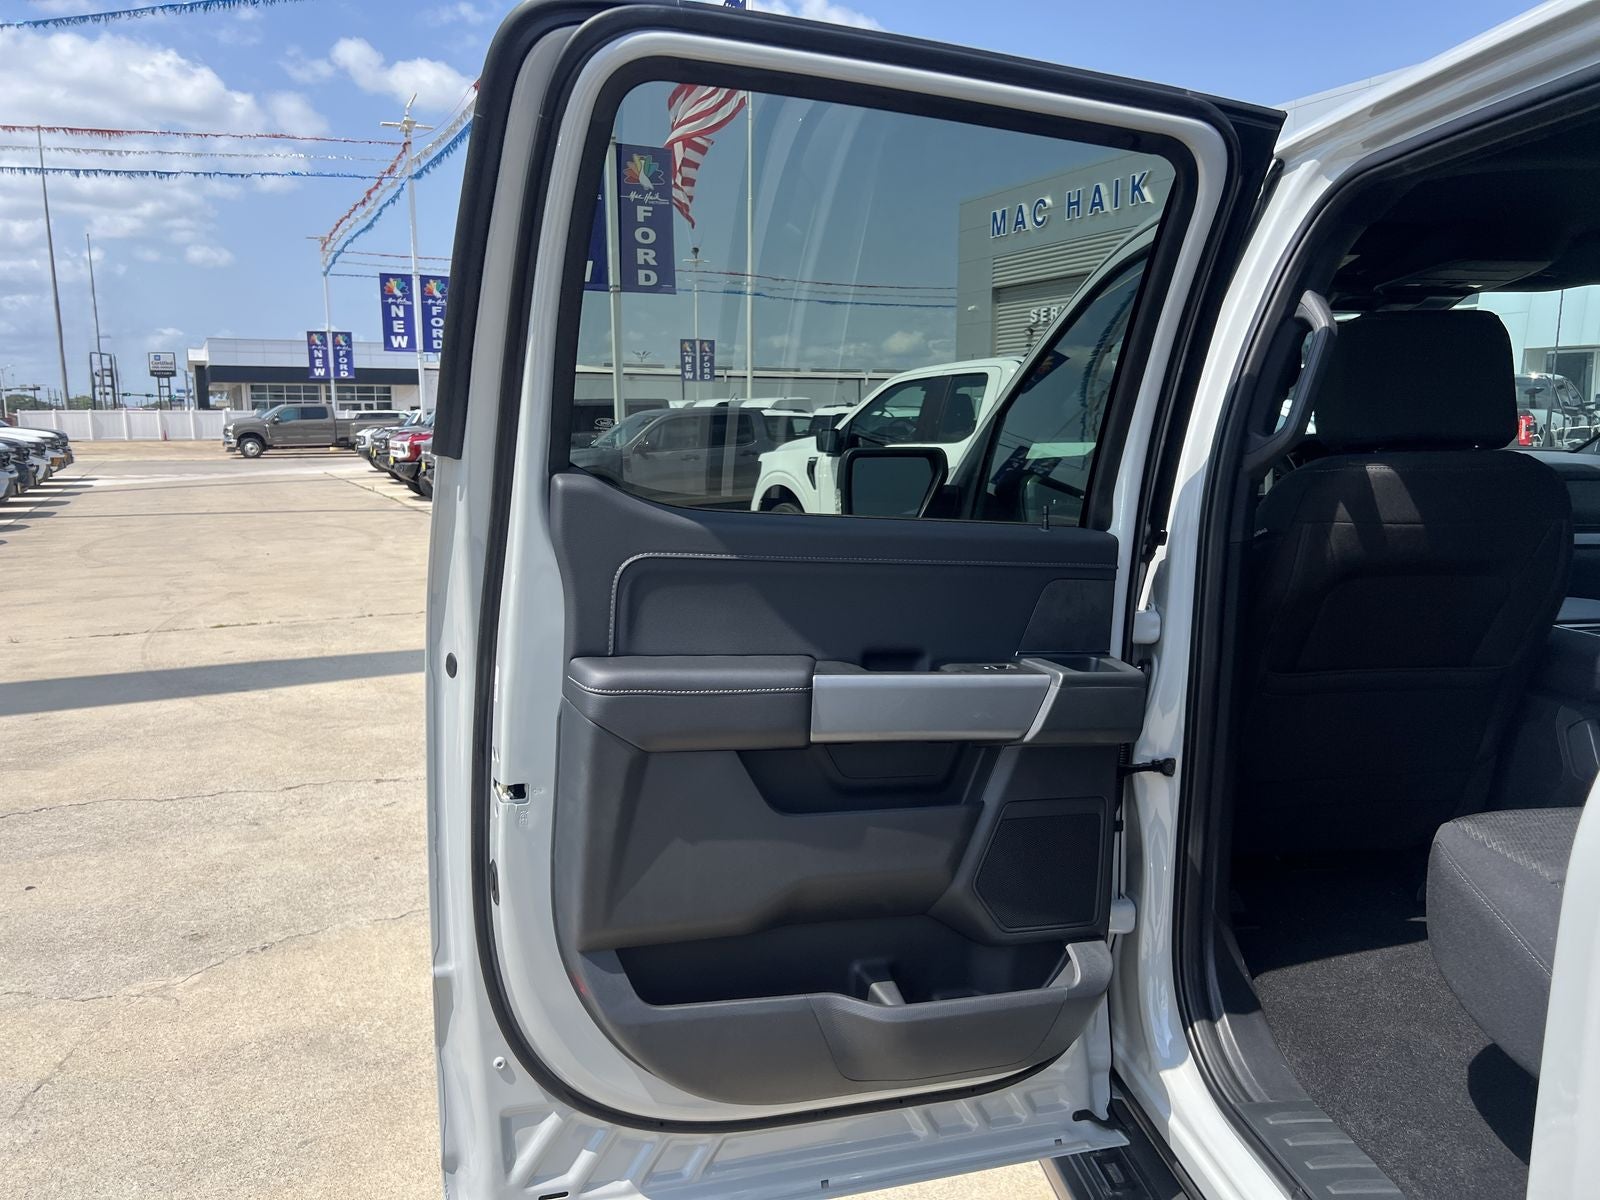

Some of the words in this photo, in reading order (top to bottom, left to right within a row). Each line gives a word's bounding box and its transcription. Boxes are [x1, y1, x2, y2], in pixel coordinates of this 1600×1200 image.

[990, 196, 1052, 239] MAC
[1065, 169, 1153, 221] HAIK
[634, 205, 658, 287] FORD
[390, 304, 408, 349] NEW
[430, 306, 444, 350] FORD
[1030, 306, 1064, 323] SER
[313, 349, 325, 376] NEW
[338, 350, 349, 377] FORD
[684, 355, 694, 379] NEW
